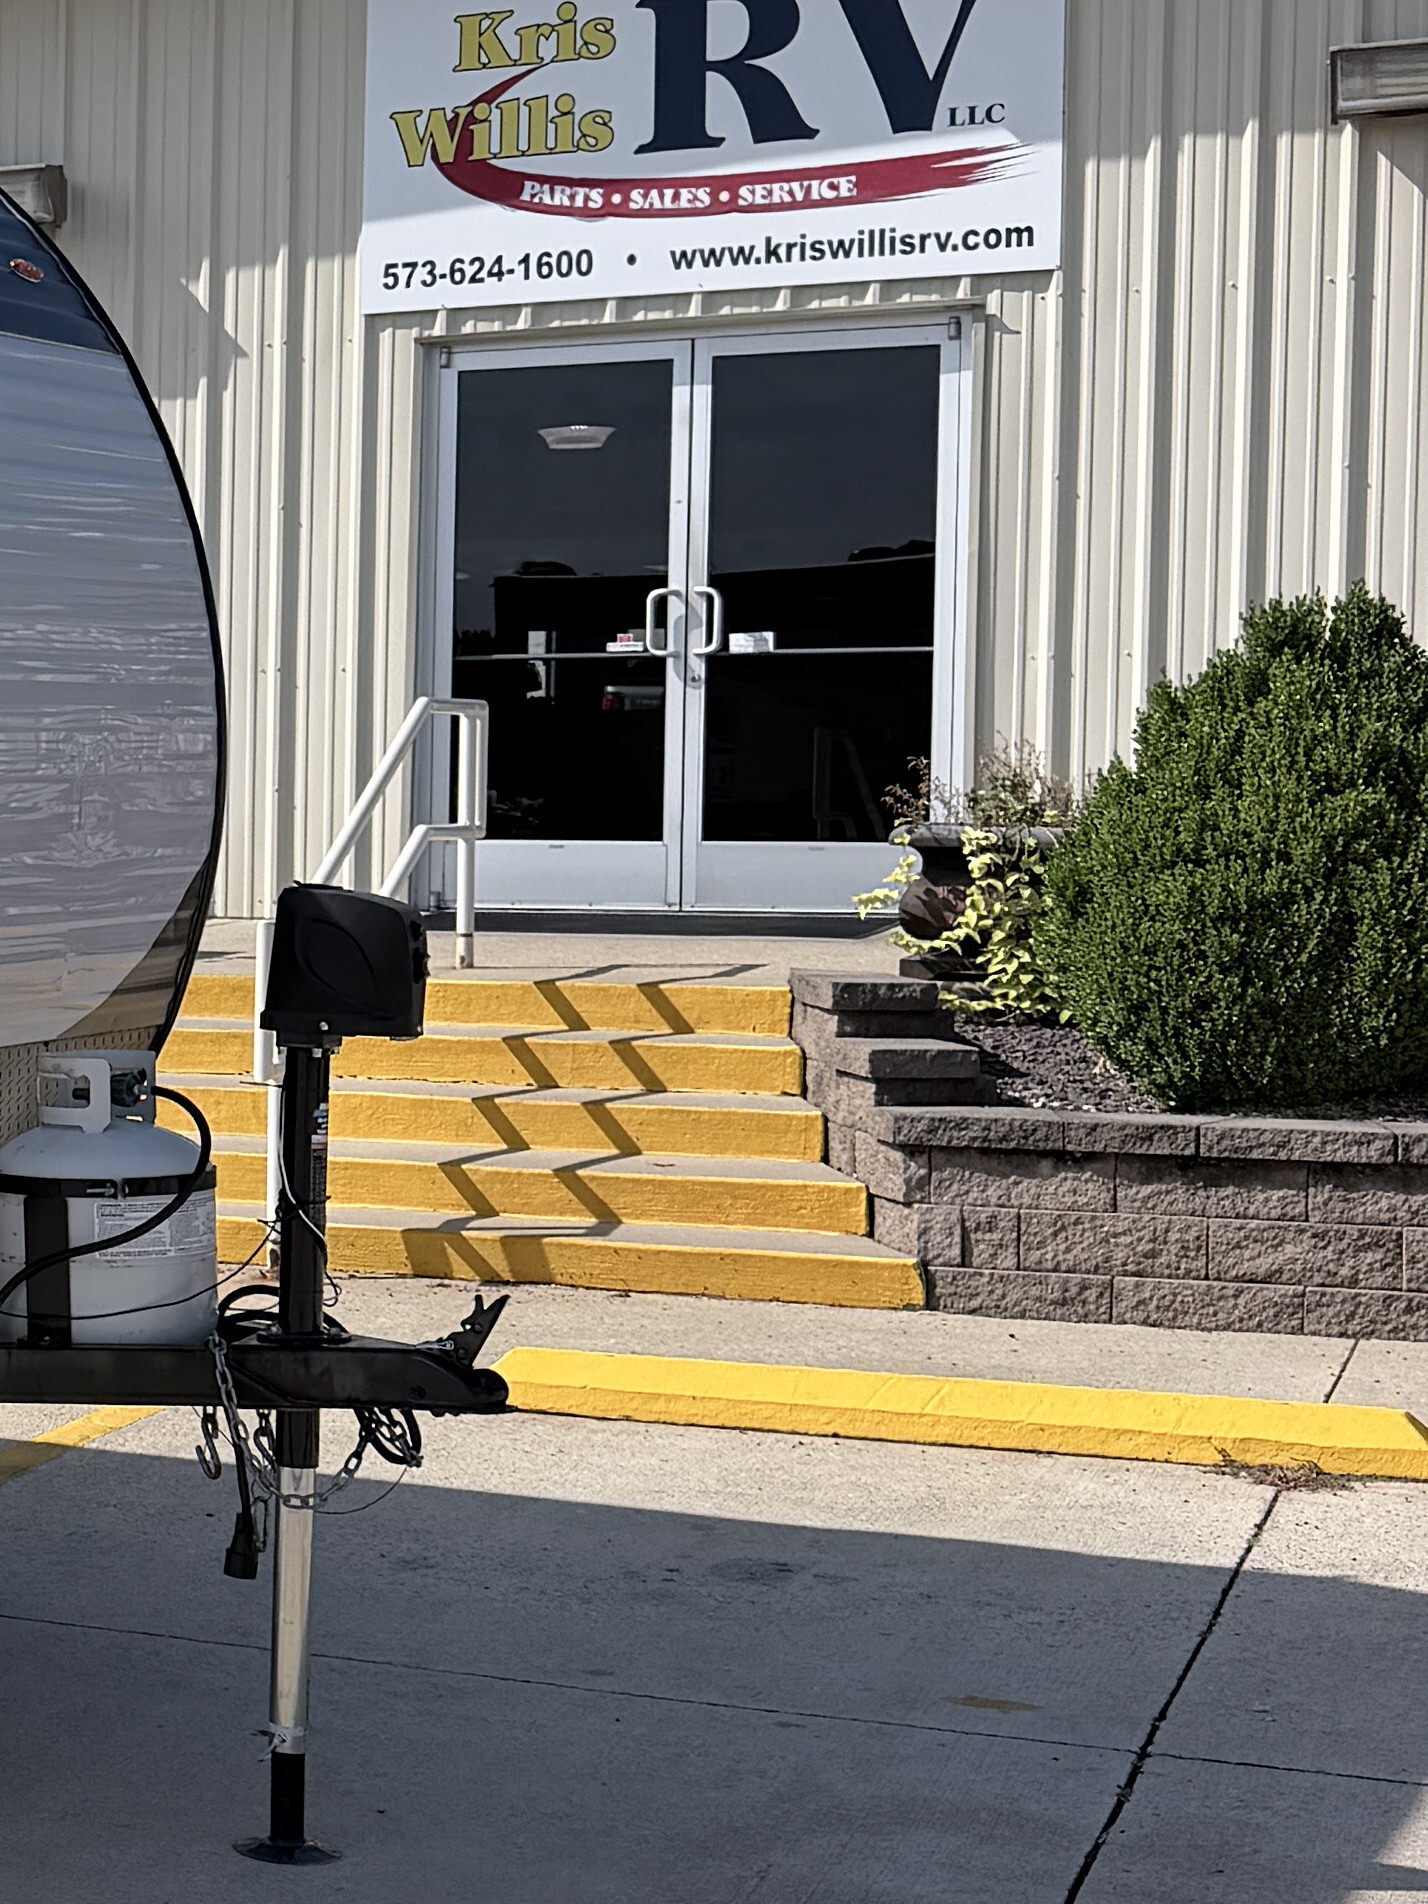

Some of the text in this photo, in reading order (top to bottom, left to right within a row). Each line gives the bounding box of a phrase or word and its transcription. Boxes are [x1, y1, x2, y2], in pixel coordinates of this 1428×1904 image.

[453, 1, 616, 73] Kris
[390, 93, 614, 169] Willis
[947, 102, 1007, 129] LLC
[519, 174, 858, 210] PARTS SALES SERVICE
[382, 222, 1036, 292] 573-624-1600 www.kriswillisrv.com
